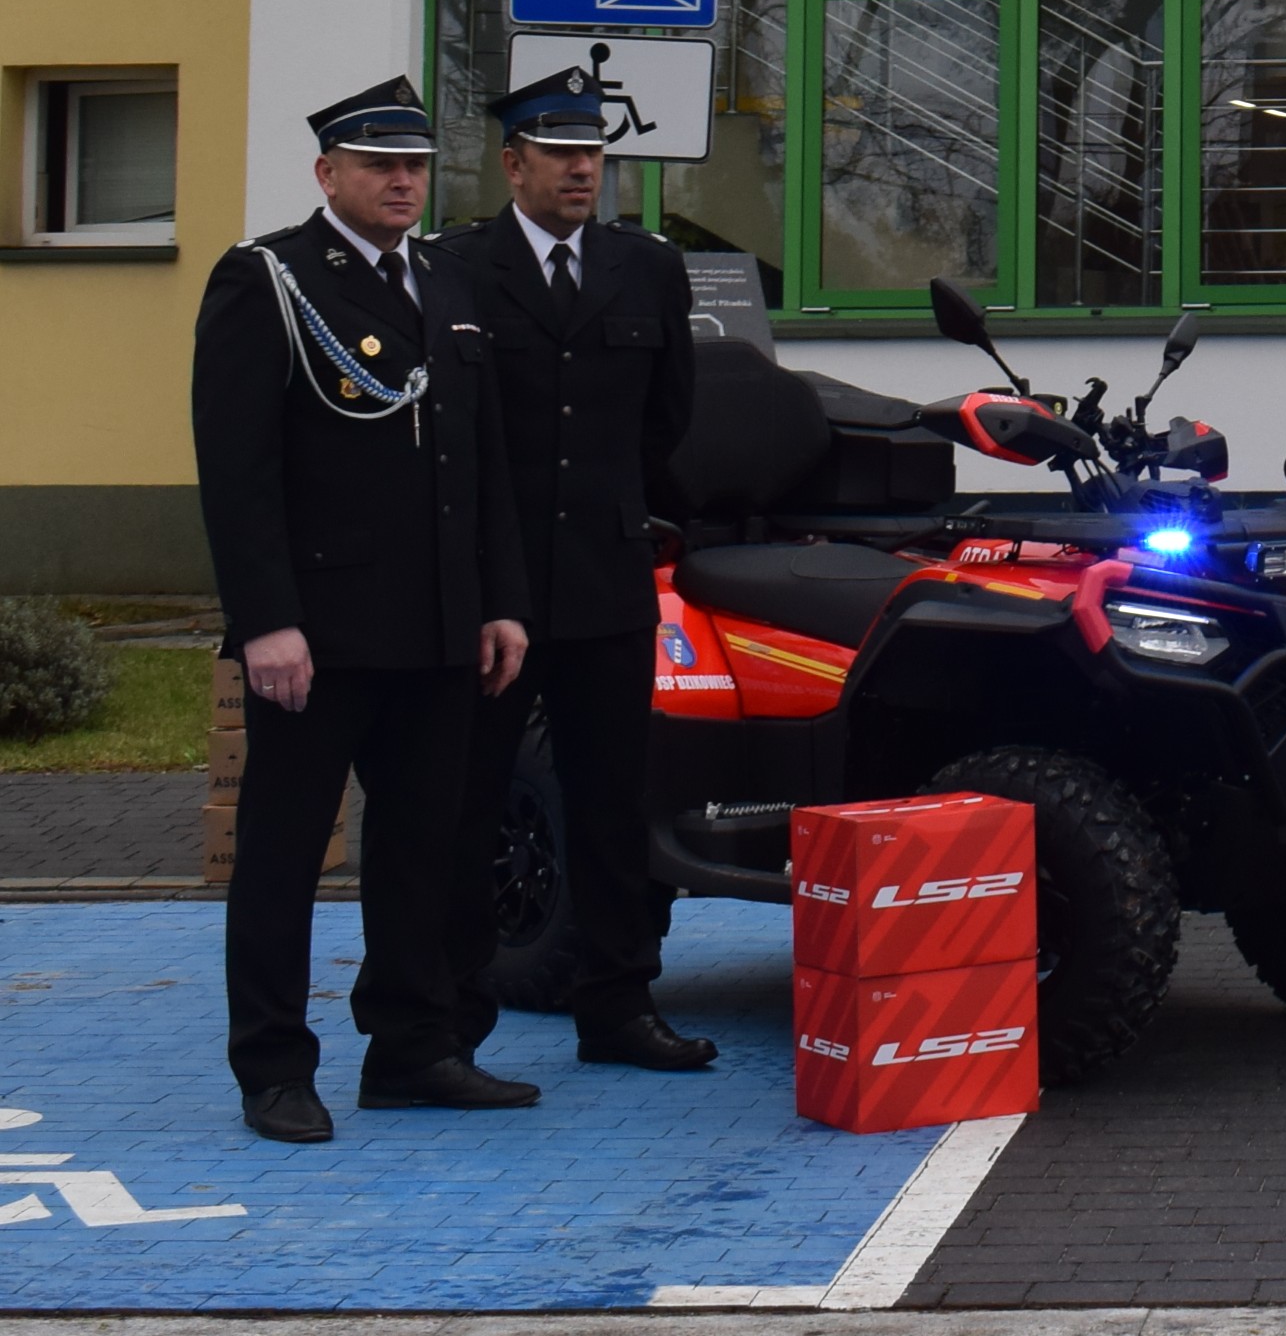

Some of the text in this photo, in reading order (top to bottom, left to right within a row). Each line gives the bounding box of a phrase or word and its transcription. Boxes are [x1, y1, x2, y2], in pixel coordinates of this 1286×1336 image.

[675, 674, 736, 690] DZIKOWIEC
[798, 880, 850, 905] LS2
[872, 872, 1024, 909] LS2
[800, 1033, 850, 1062] LS2
[872, 1026, 1025, 1066] LS2
